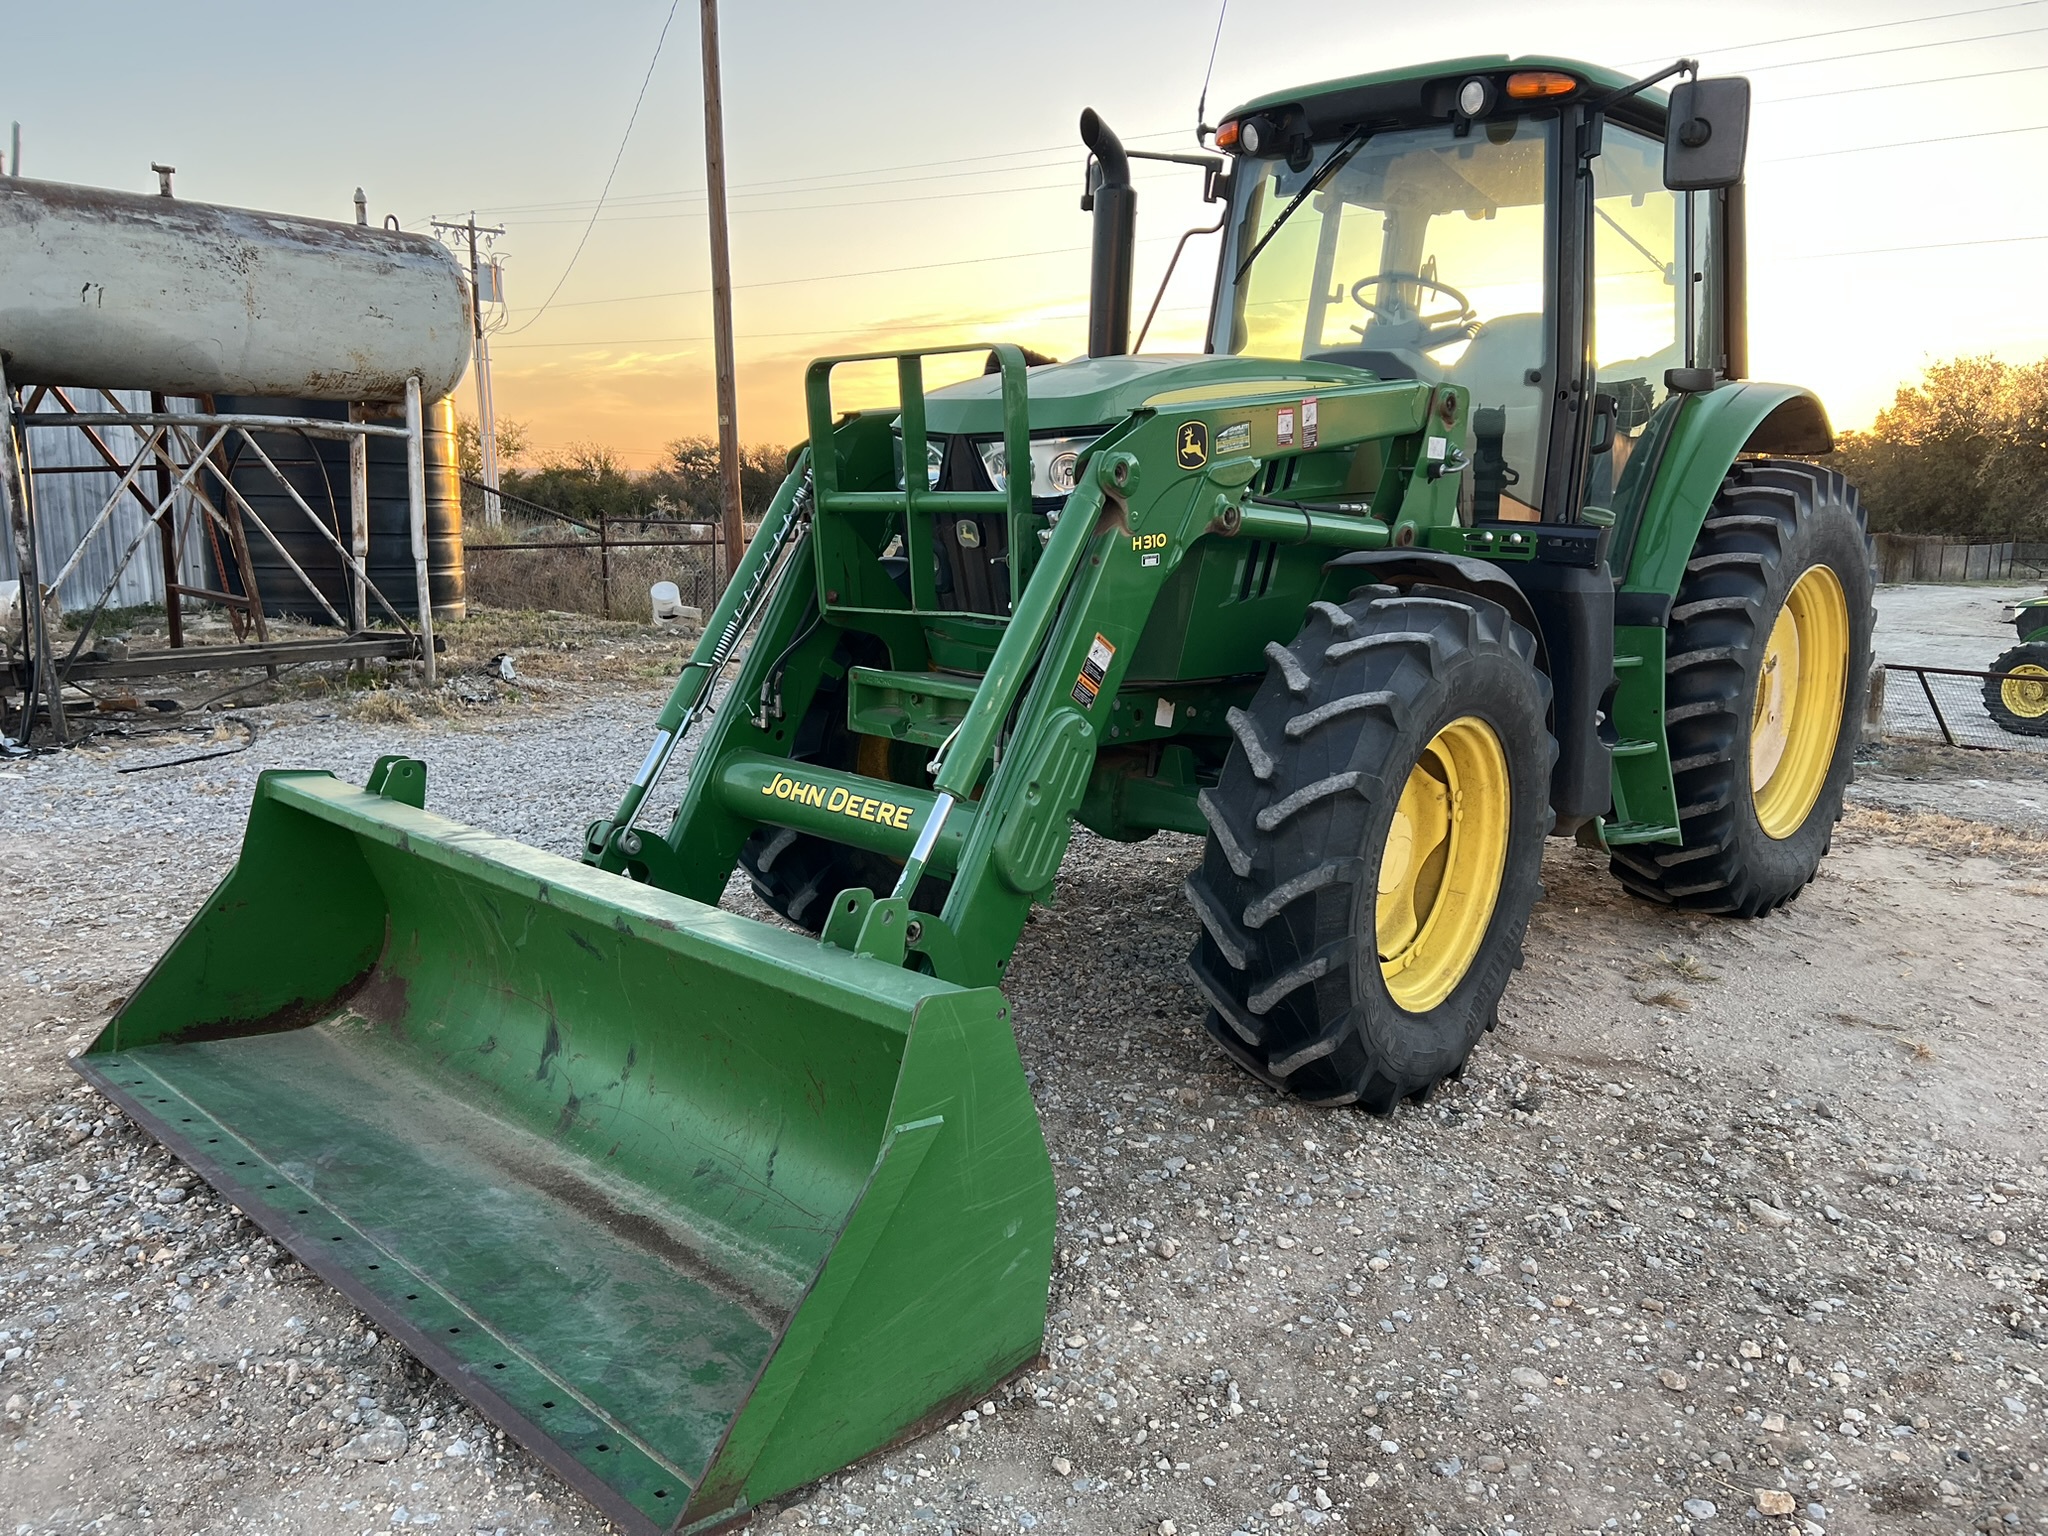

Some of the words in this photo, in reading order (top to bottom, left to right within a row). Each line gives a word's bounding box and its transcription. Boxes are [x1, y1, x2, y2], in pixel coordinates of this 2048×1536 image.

[1132, 533, 1167, 551] H310
[762, 773, 827, 807] JOHN
[826, 787, 914, 829] DEERE
